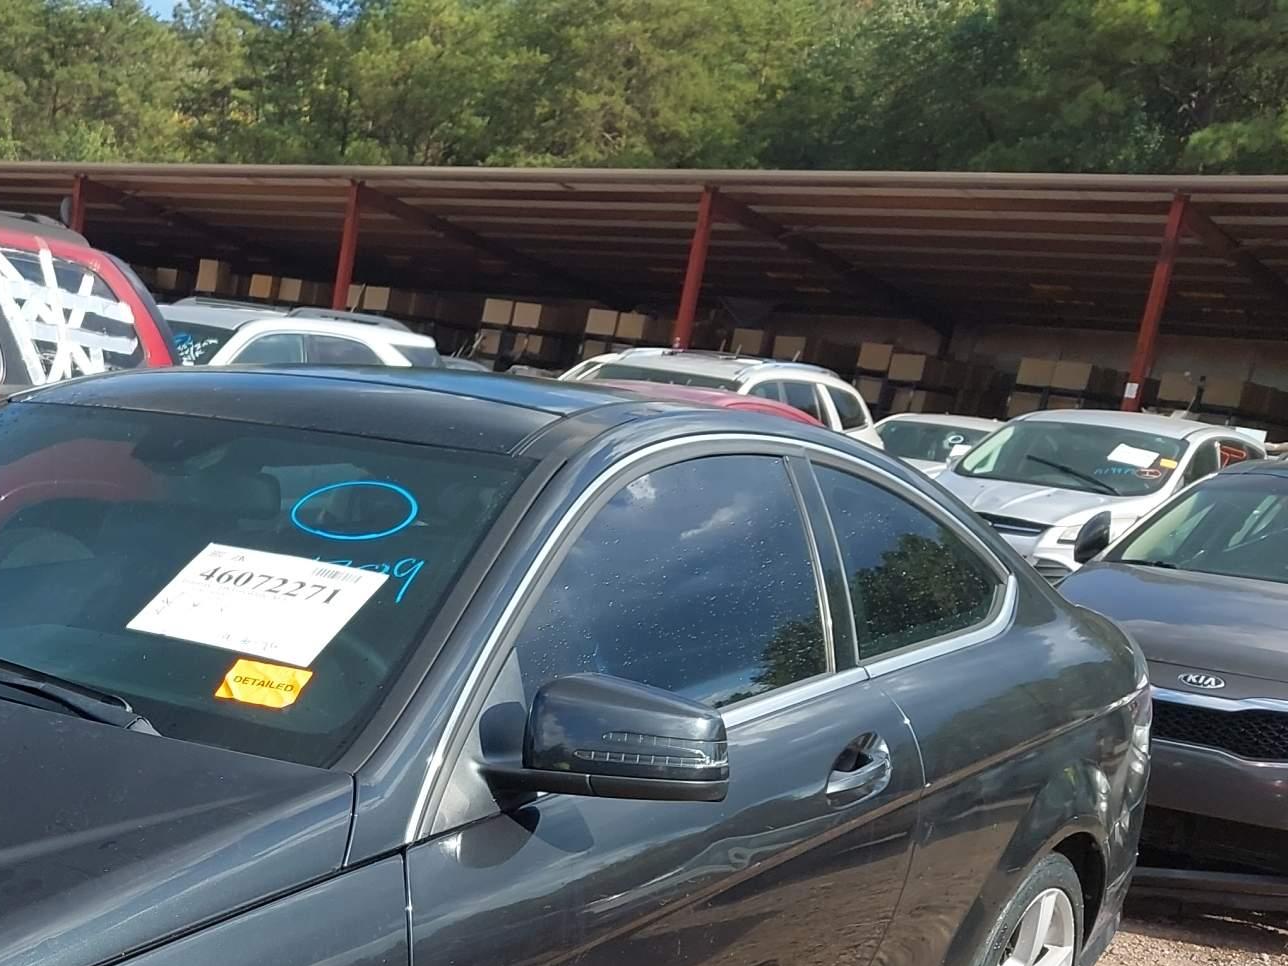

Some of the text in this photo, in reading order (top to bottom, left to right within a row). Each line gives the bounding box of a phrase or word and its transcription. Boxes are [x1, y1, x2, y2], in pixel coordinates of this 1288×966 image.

[199, 565, 342, 605] 46072271
[232, 675, 294, 693] DETAILED
[1186, 673, 1216, 687] KIA
